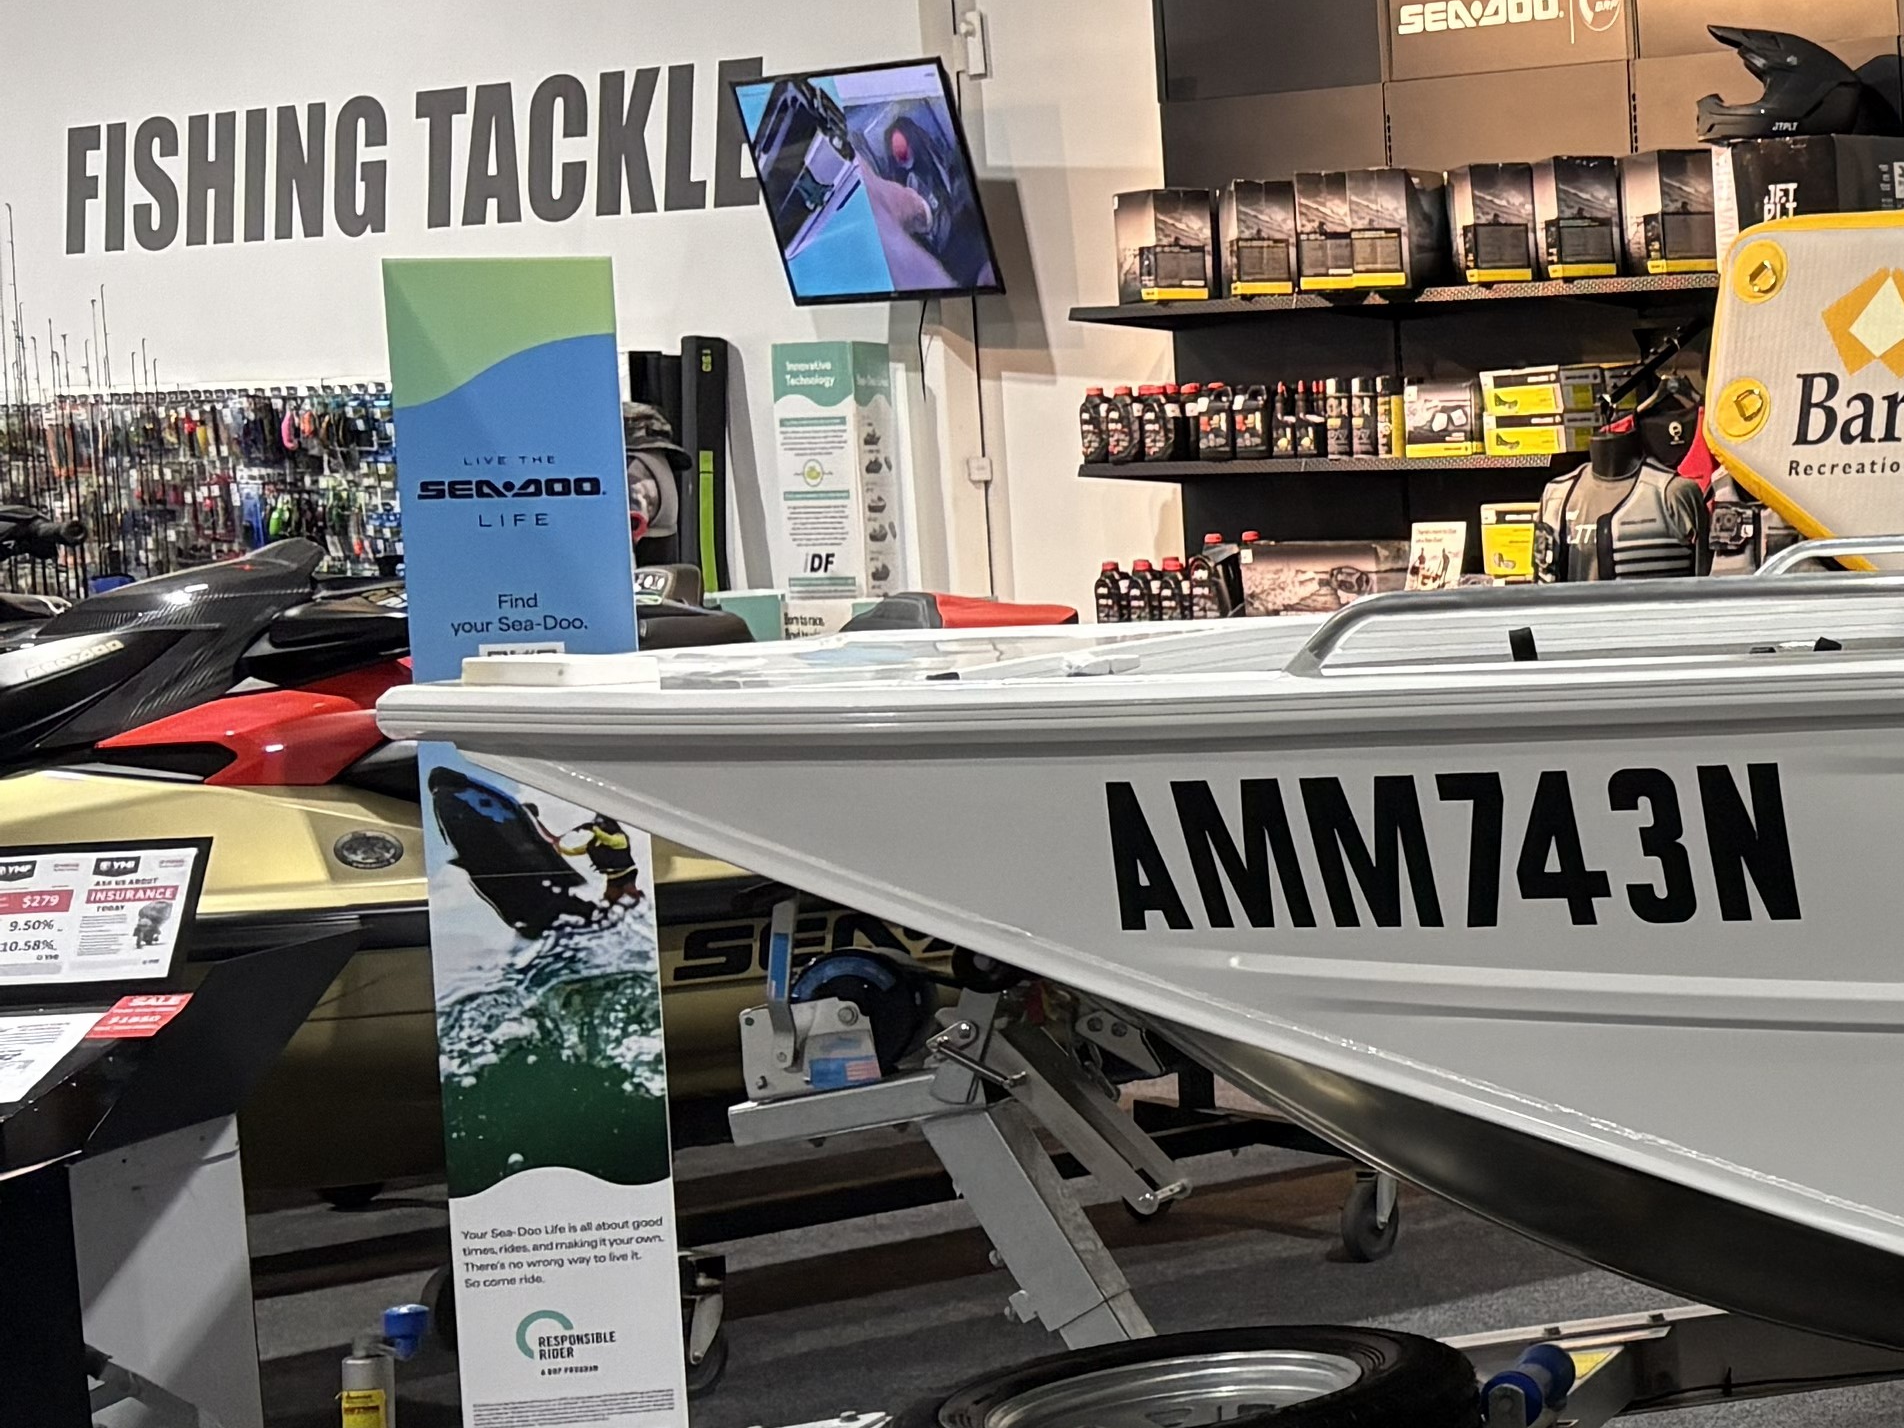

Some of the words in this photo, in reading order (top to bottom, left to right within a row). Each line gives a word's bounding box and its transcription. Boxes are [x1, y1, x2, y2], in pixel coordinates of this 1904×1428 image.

[66, 95, 389, 255] FISHING
[414, 57, 763, 231] TACKLE
[785, 360, 832, 372] Innovative
[785, 374, 836, 389] Technology
[463, 455, 507, 467] LIVE
[518, 455, 556, 466] THE
[478, 512, 549, 528] LIFE
[497, 592, 538, 610] Find
[450, 618, 493, 637] your
[498, 615, 589, 633] Sea-Doo.
[1105, 762, 1802, 932] AMM743N
[22, 894, 60, 909] $279
[90, 887, 175, 902] INSURANCE
[96, 904, 126, 913] TODAY
[9, 919, 54, 932] 9.50%
[0, 939, 55, 952] 10.58%
[461, 1230, 488, 1241] Your
[490, 1226, 543, 1240] Sea-Doo
[544, 1225, 566, 1236] Life
[567, 1223, 578, 1234] is
[579, 1222, 593, 1233] all
[595, 1219, 630, 1232] about
[632, 1216, 664, 1231] good
[532, 1241, 554, 1252] and
[555, 1238, 599, 1251] making
[608, 1235, 634, 1248] your
[635, 1234, 665, 1245] own.
[463, 1260, 506, 1273] There's
[508, 1260, 524, 1270] no
[526, 1256, 565, 1270] wrong
[566, 1255, 592, 1268] way
[593, 1253, 607, 1264] to
[608, 1251, 629, 1262] live
[464, 1277, 481, 1289] So
[482, 1276, 517, 1288] come
[518, 1274, 546, 1286] ride.
[538, 1330, 617, 1348] RESPONSIBLE
[538, 1346, 575, 1361] RIDER
